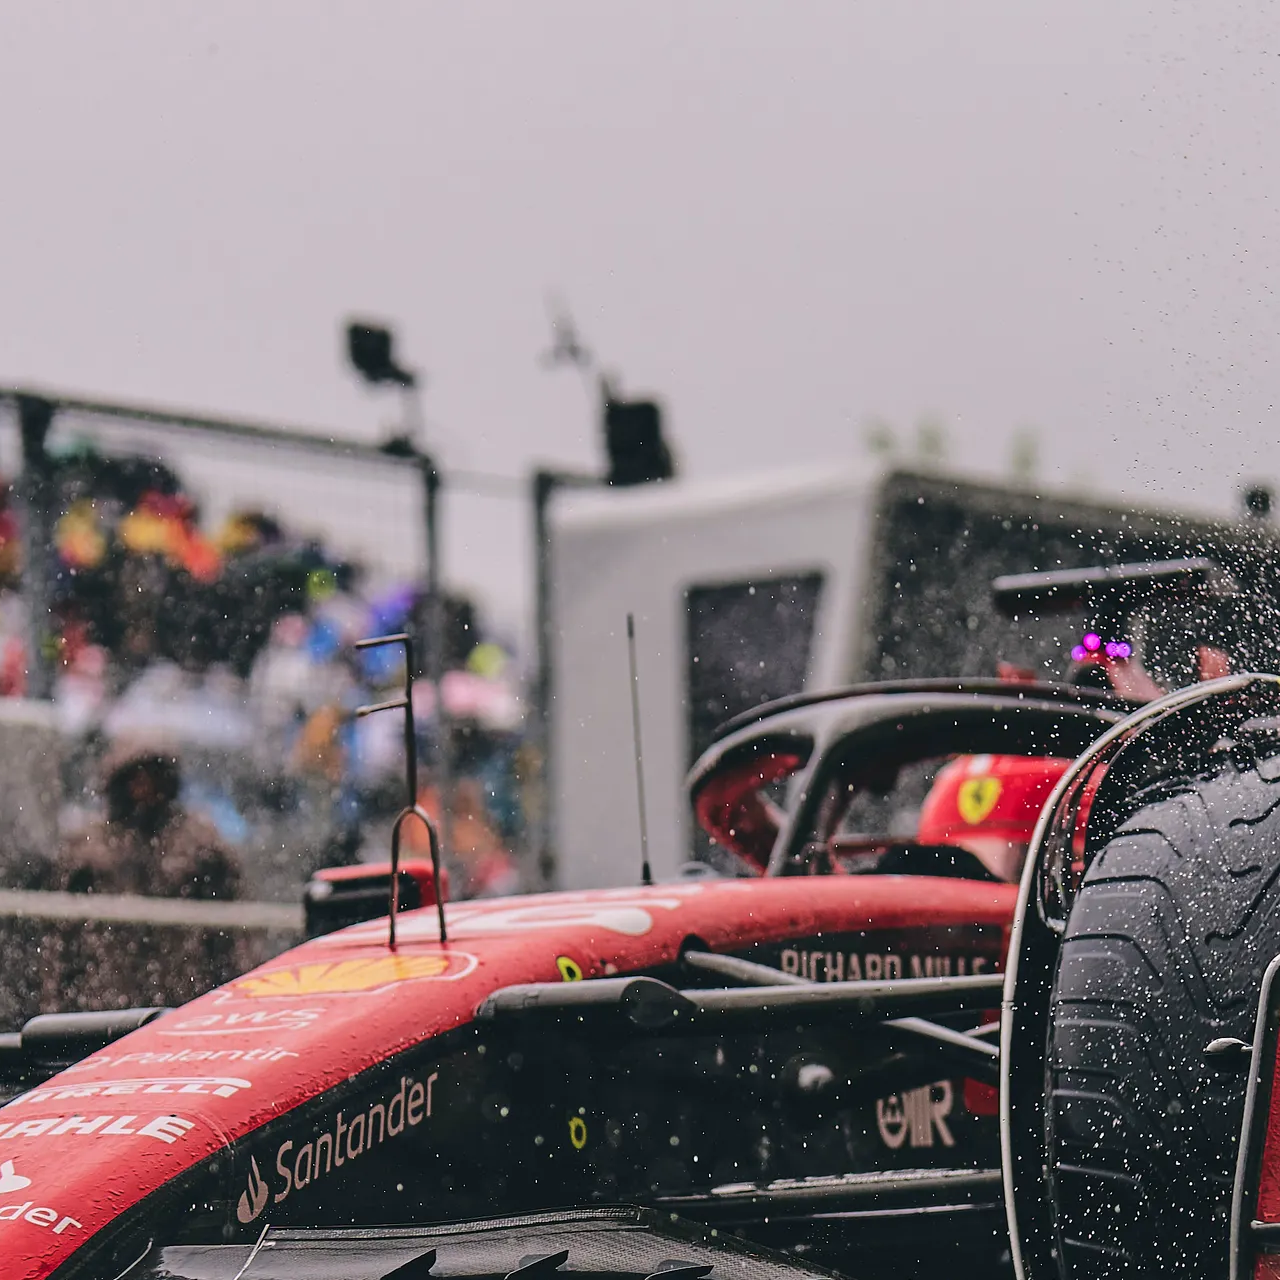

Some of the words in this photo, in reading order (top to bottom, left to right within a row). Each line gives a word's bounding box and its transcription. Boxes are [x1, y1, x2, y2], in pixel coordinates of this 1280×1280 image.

[173, 1008, 326, 1029] aws
[109, 1047, 300, 1068] Palantir
[274, 1072, 438, 1203] Santander
